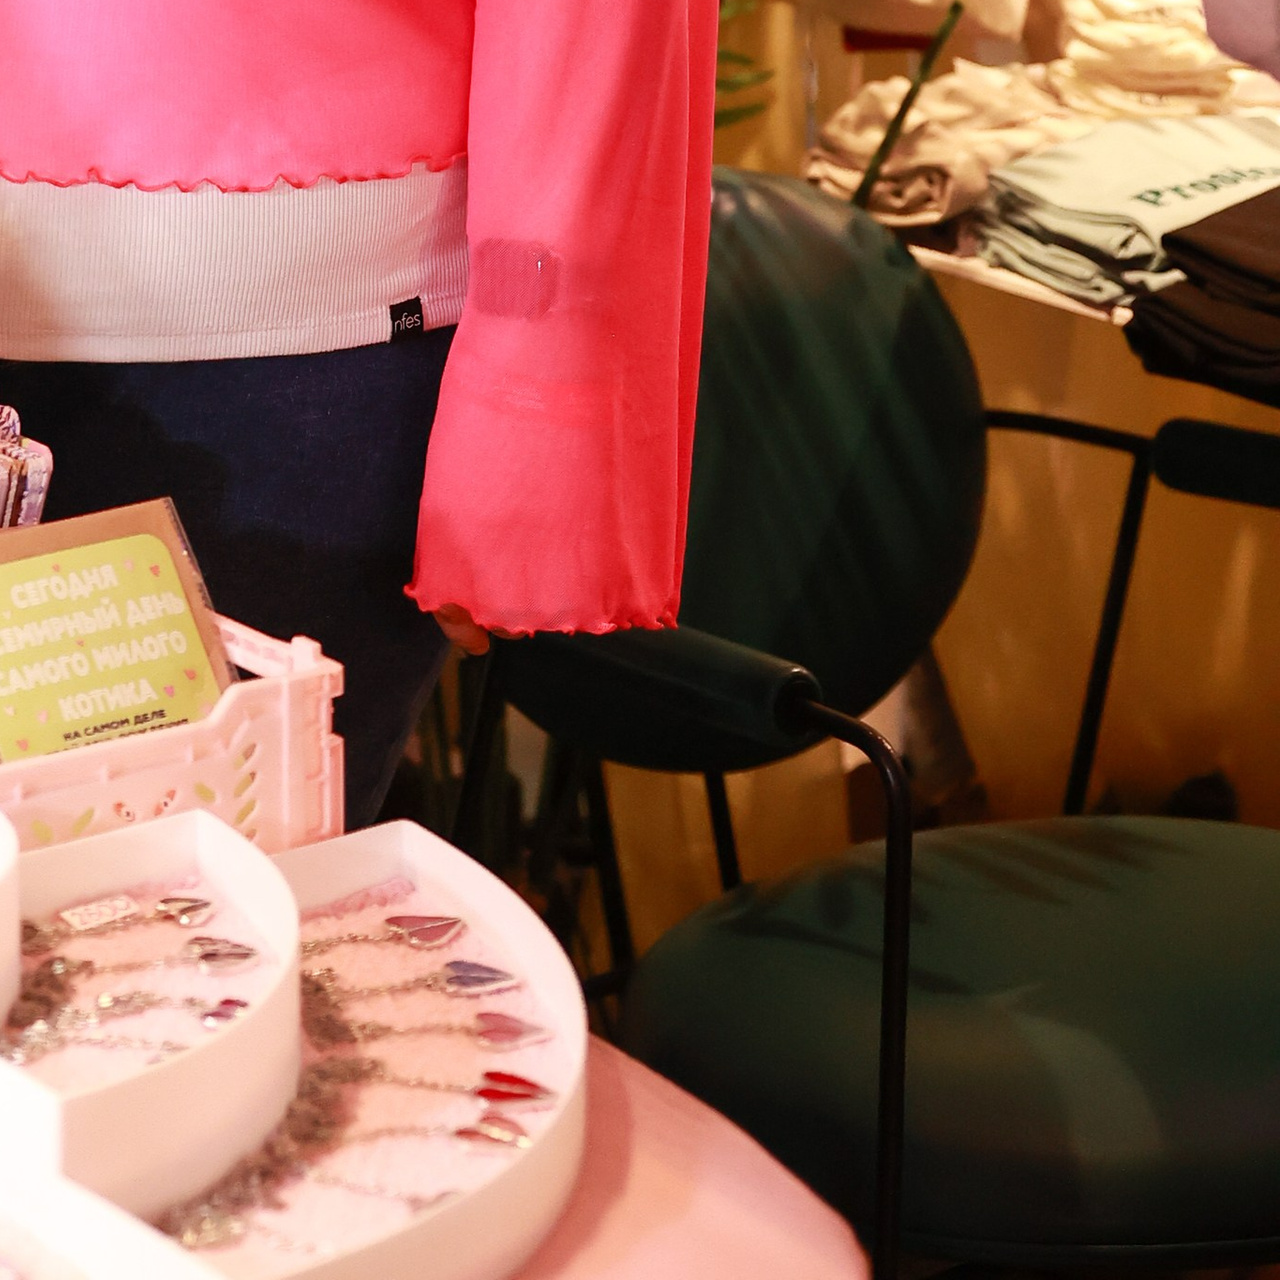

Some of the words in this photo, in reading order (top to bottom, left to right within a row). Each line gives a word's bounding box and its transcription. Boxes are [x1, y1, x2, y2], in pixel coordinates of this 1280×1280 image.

[394, 312, 421, 333] nfes
[10, 564, 119, 609] СЕГОДНЯ
[126, 590, 185, 628] ДЕНЬ
[92, 630, 187, 672] МИЛОГО
[58, 678, 159, 722] КОТИКА
[63, 730, 82, 741] НА
[84, 717, 130, 737] САМОМ
[134, 709, 167, 726] ДЕЛЕ
